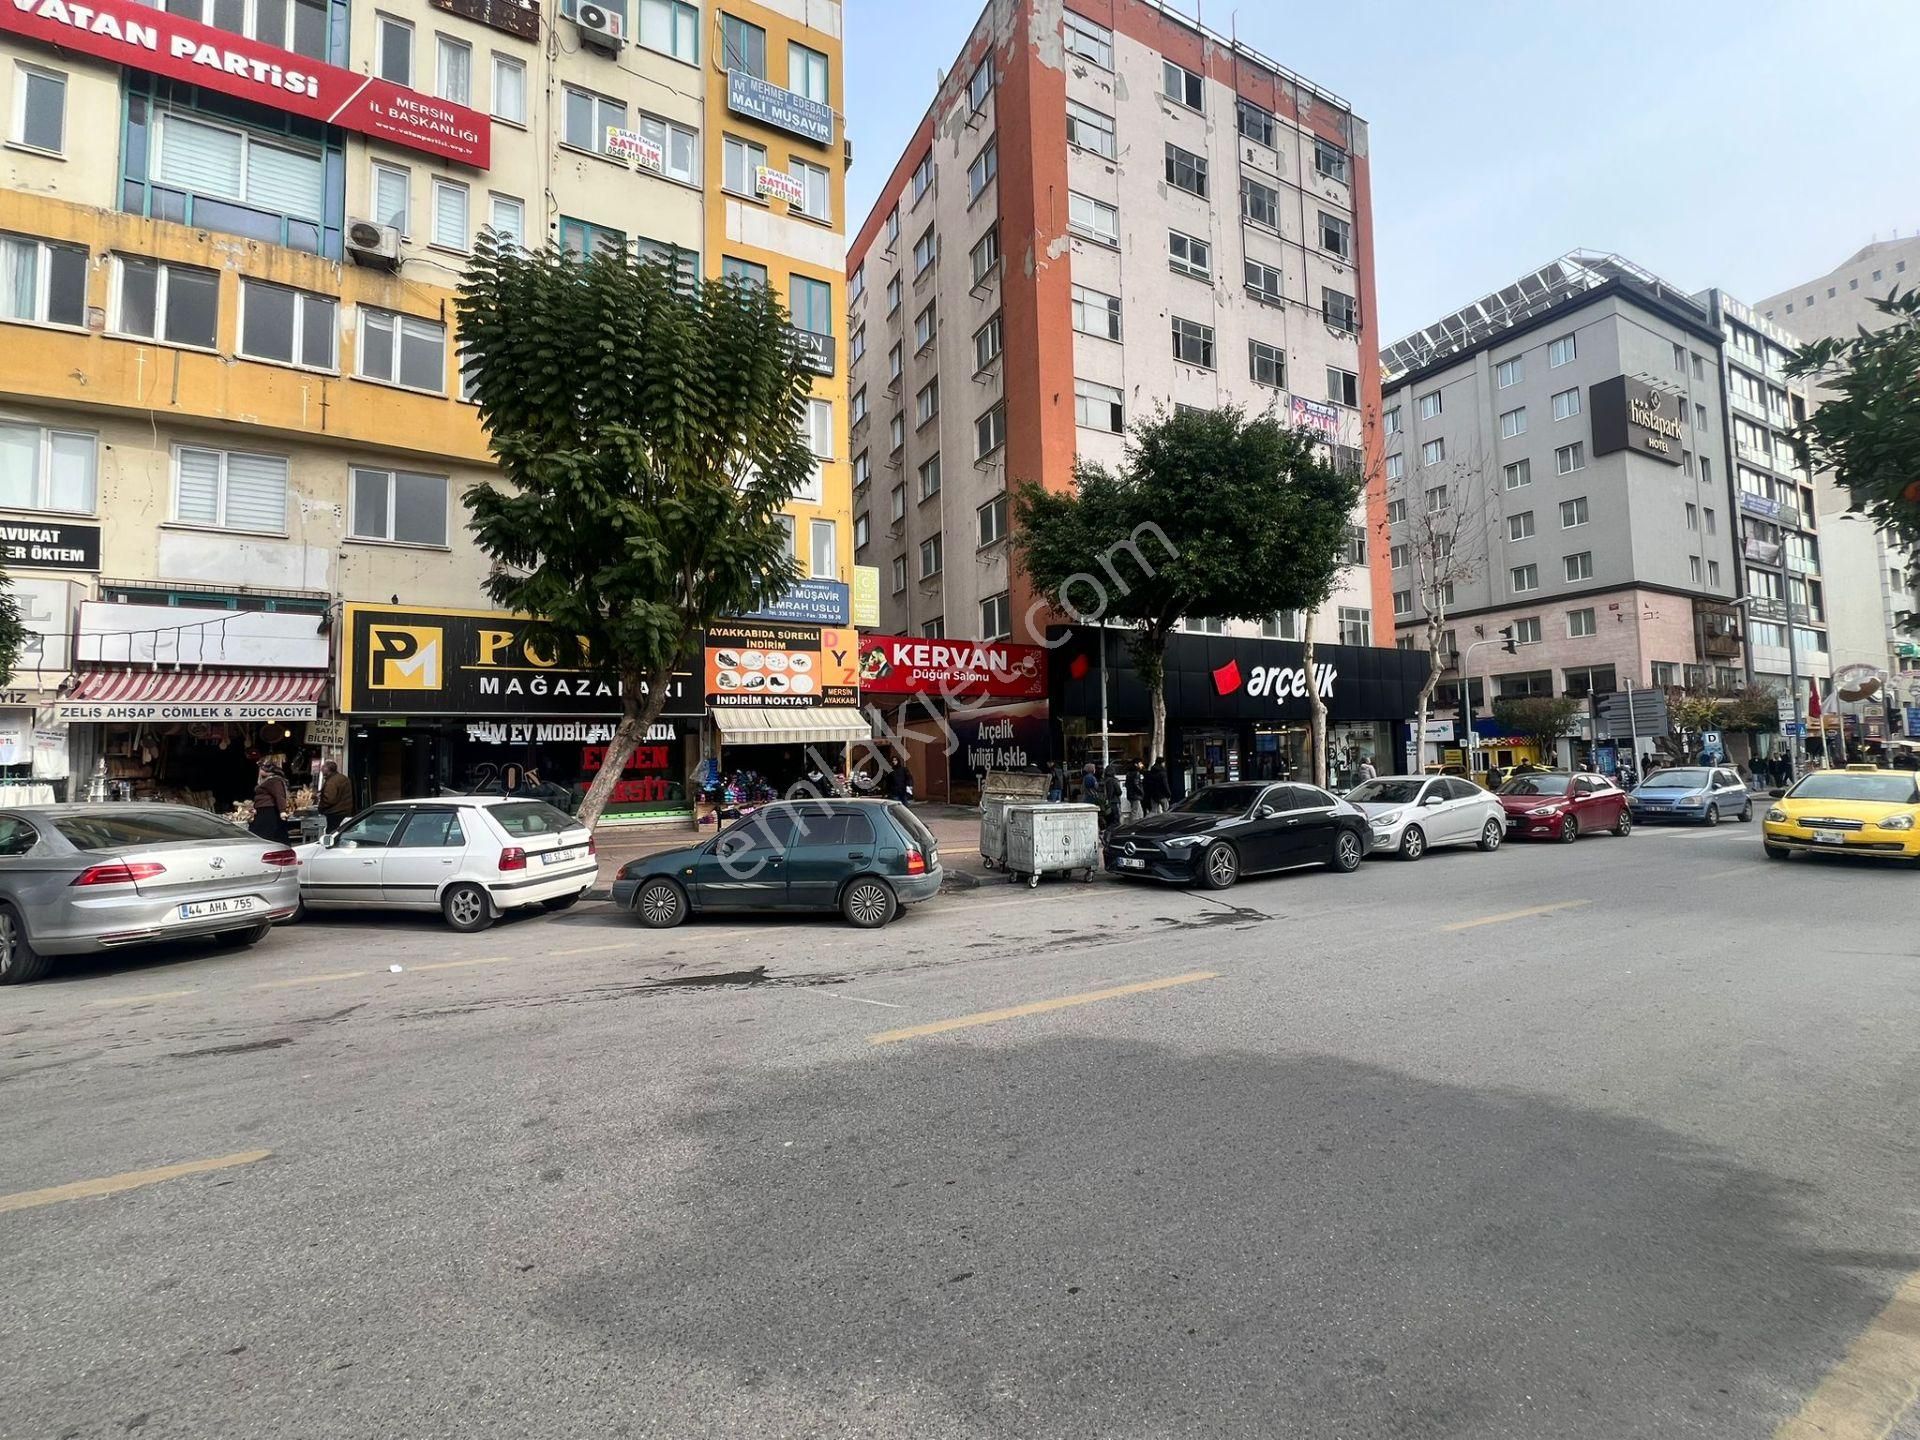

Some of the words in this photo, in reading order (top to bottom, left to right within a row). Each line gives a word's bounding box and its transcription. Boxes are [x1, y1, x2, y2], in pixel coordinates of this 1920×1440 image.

[12, 0, 157, 51] VATAN
[751, 79, 788, 102] MEHMET
[396, 97, 454, 123] MERSİN
[388, 108, 478, 143] BAŞKANLIĞI
[608, 146, 625, 157] 0546
[627, 151, 640, 162] 413
[609, 137, 660, 162] SATILIK
[760, 176, 802, 199] SATILIK
[1631, 399, 1682, 439] hostapark
[1648, 437, 1669, 453] HOTEL
[0, 527, 61, 543] AVUKAT
[31, 545, 85, 562] ÖKTEM
[795, 589, 839, 601] MÜŞAVİR
[811, 603, 840, 613] USLU
[709, 628, 775, 639] AYAKKABIDA
[777, 630, 819, 640] SÜREKLİ
[746, 639, 786, 650] İNDİRİM
[893, 643, 1007, 671] KERVAN
[912, 668, 950, 681] Düğün
[953, 671, 989, 682] Salonu
[828, 687, 853, 695] MERSİN
[716, 694, 764, 705] İNDİRİM
[766, 696, 813, 706] NOKTASI
[824, 696, 857, 704] AYAKKABI
[106, 707, 155, 718] AHŞAP
[162, 706, 219, 718] ÇÖMLEK
[223, 708, 232, 717] &
[467, 722, 508, 744] TÜM
[510, 724, 534, 742] EV
[978, 718, 1014, 744] Arçelik
[968, 744, 995, 771] İyiliği
[996, 745, 1027, 772] Aşkla
[189, 905, 202, 914] 44
[209, 902, 228, 913] AHA
[234, 898, 252, 909] 755
